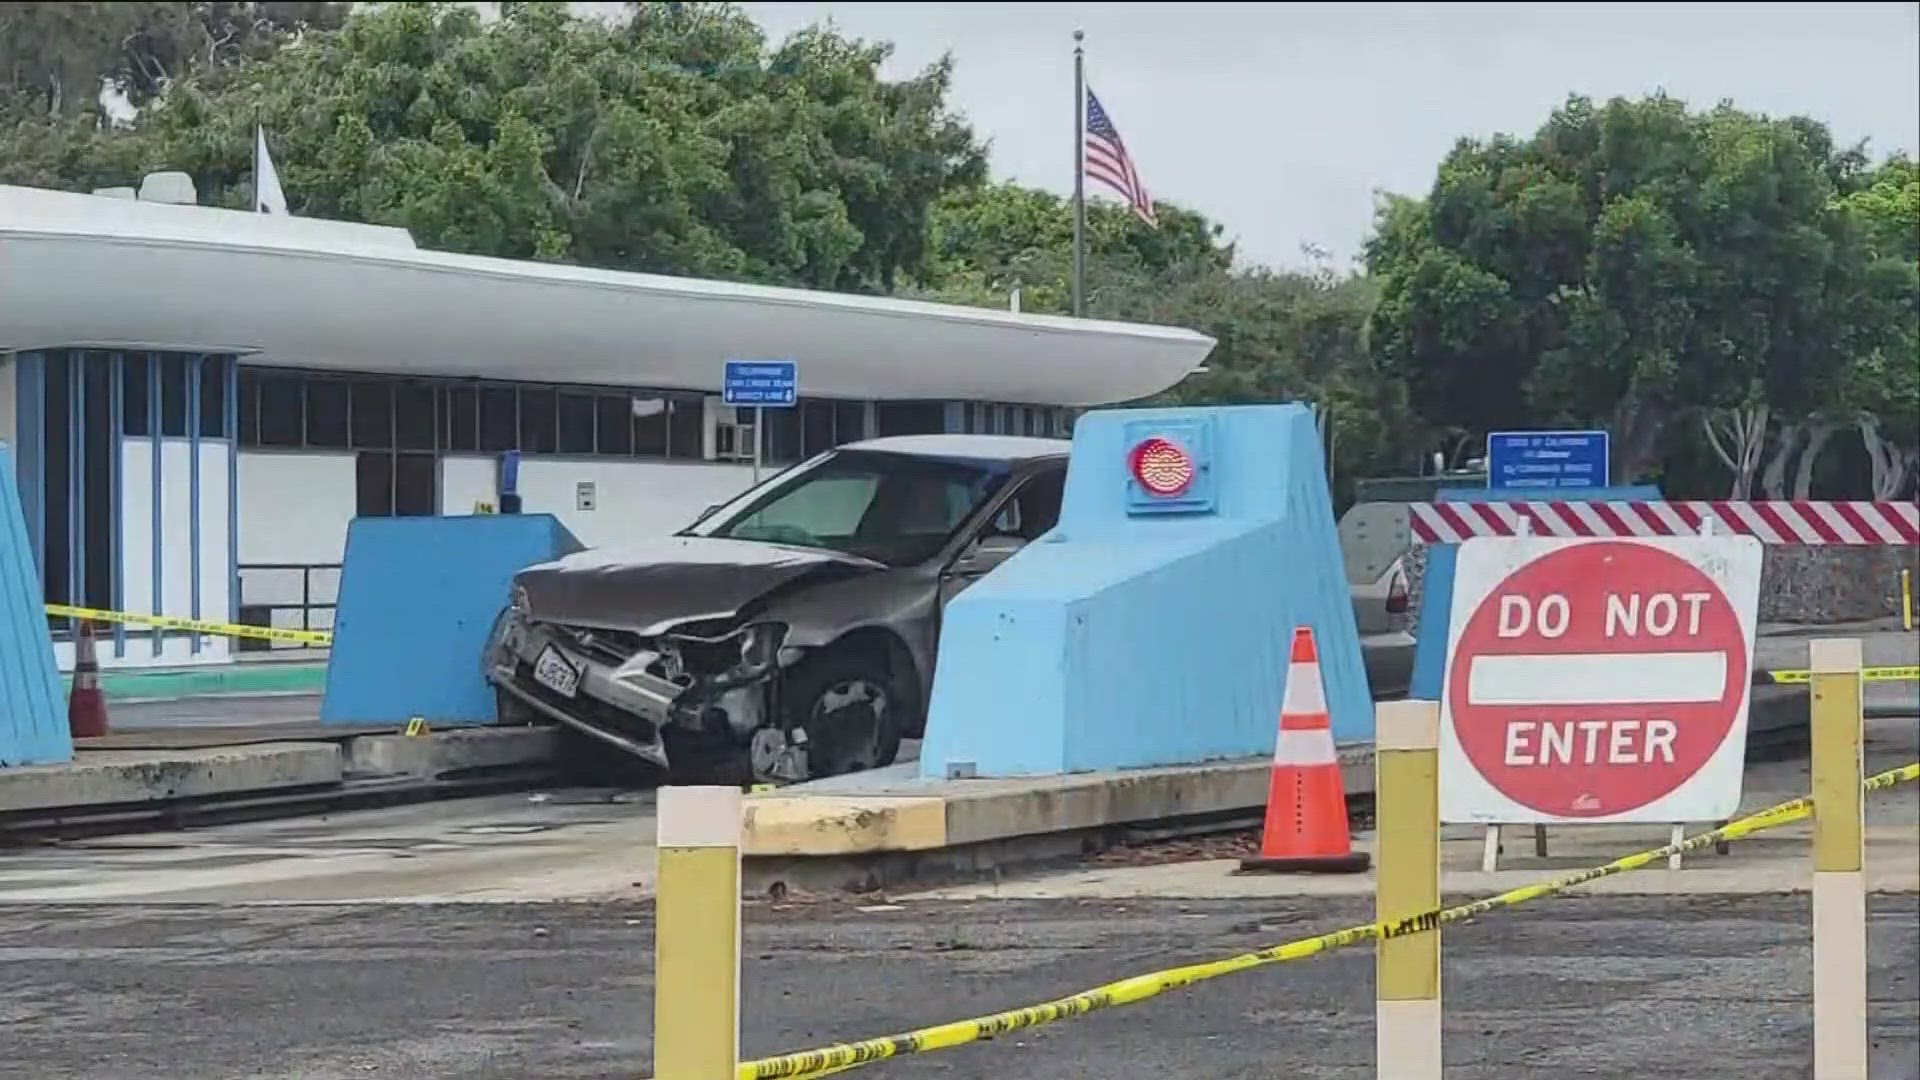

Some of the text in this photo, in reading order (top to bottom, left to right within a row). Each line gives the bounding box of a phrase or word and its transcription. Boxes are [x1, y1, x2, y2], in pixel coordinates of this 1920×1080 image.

[1498, 592, 1711, 638] DO NOT
[1504, 720, 1677, 765] ENTER
